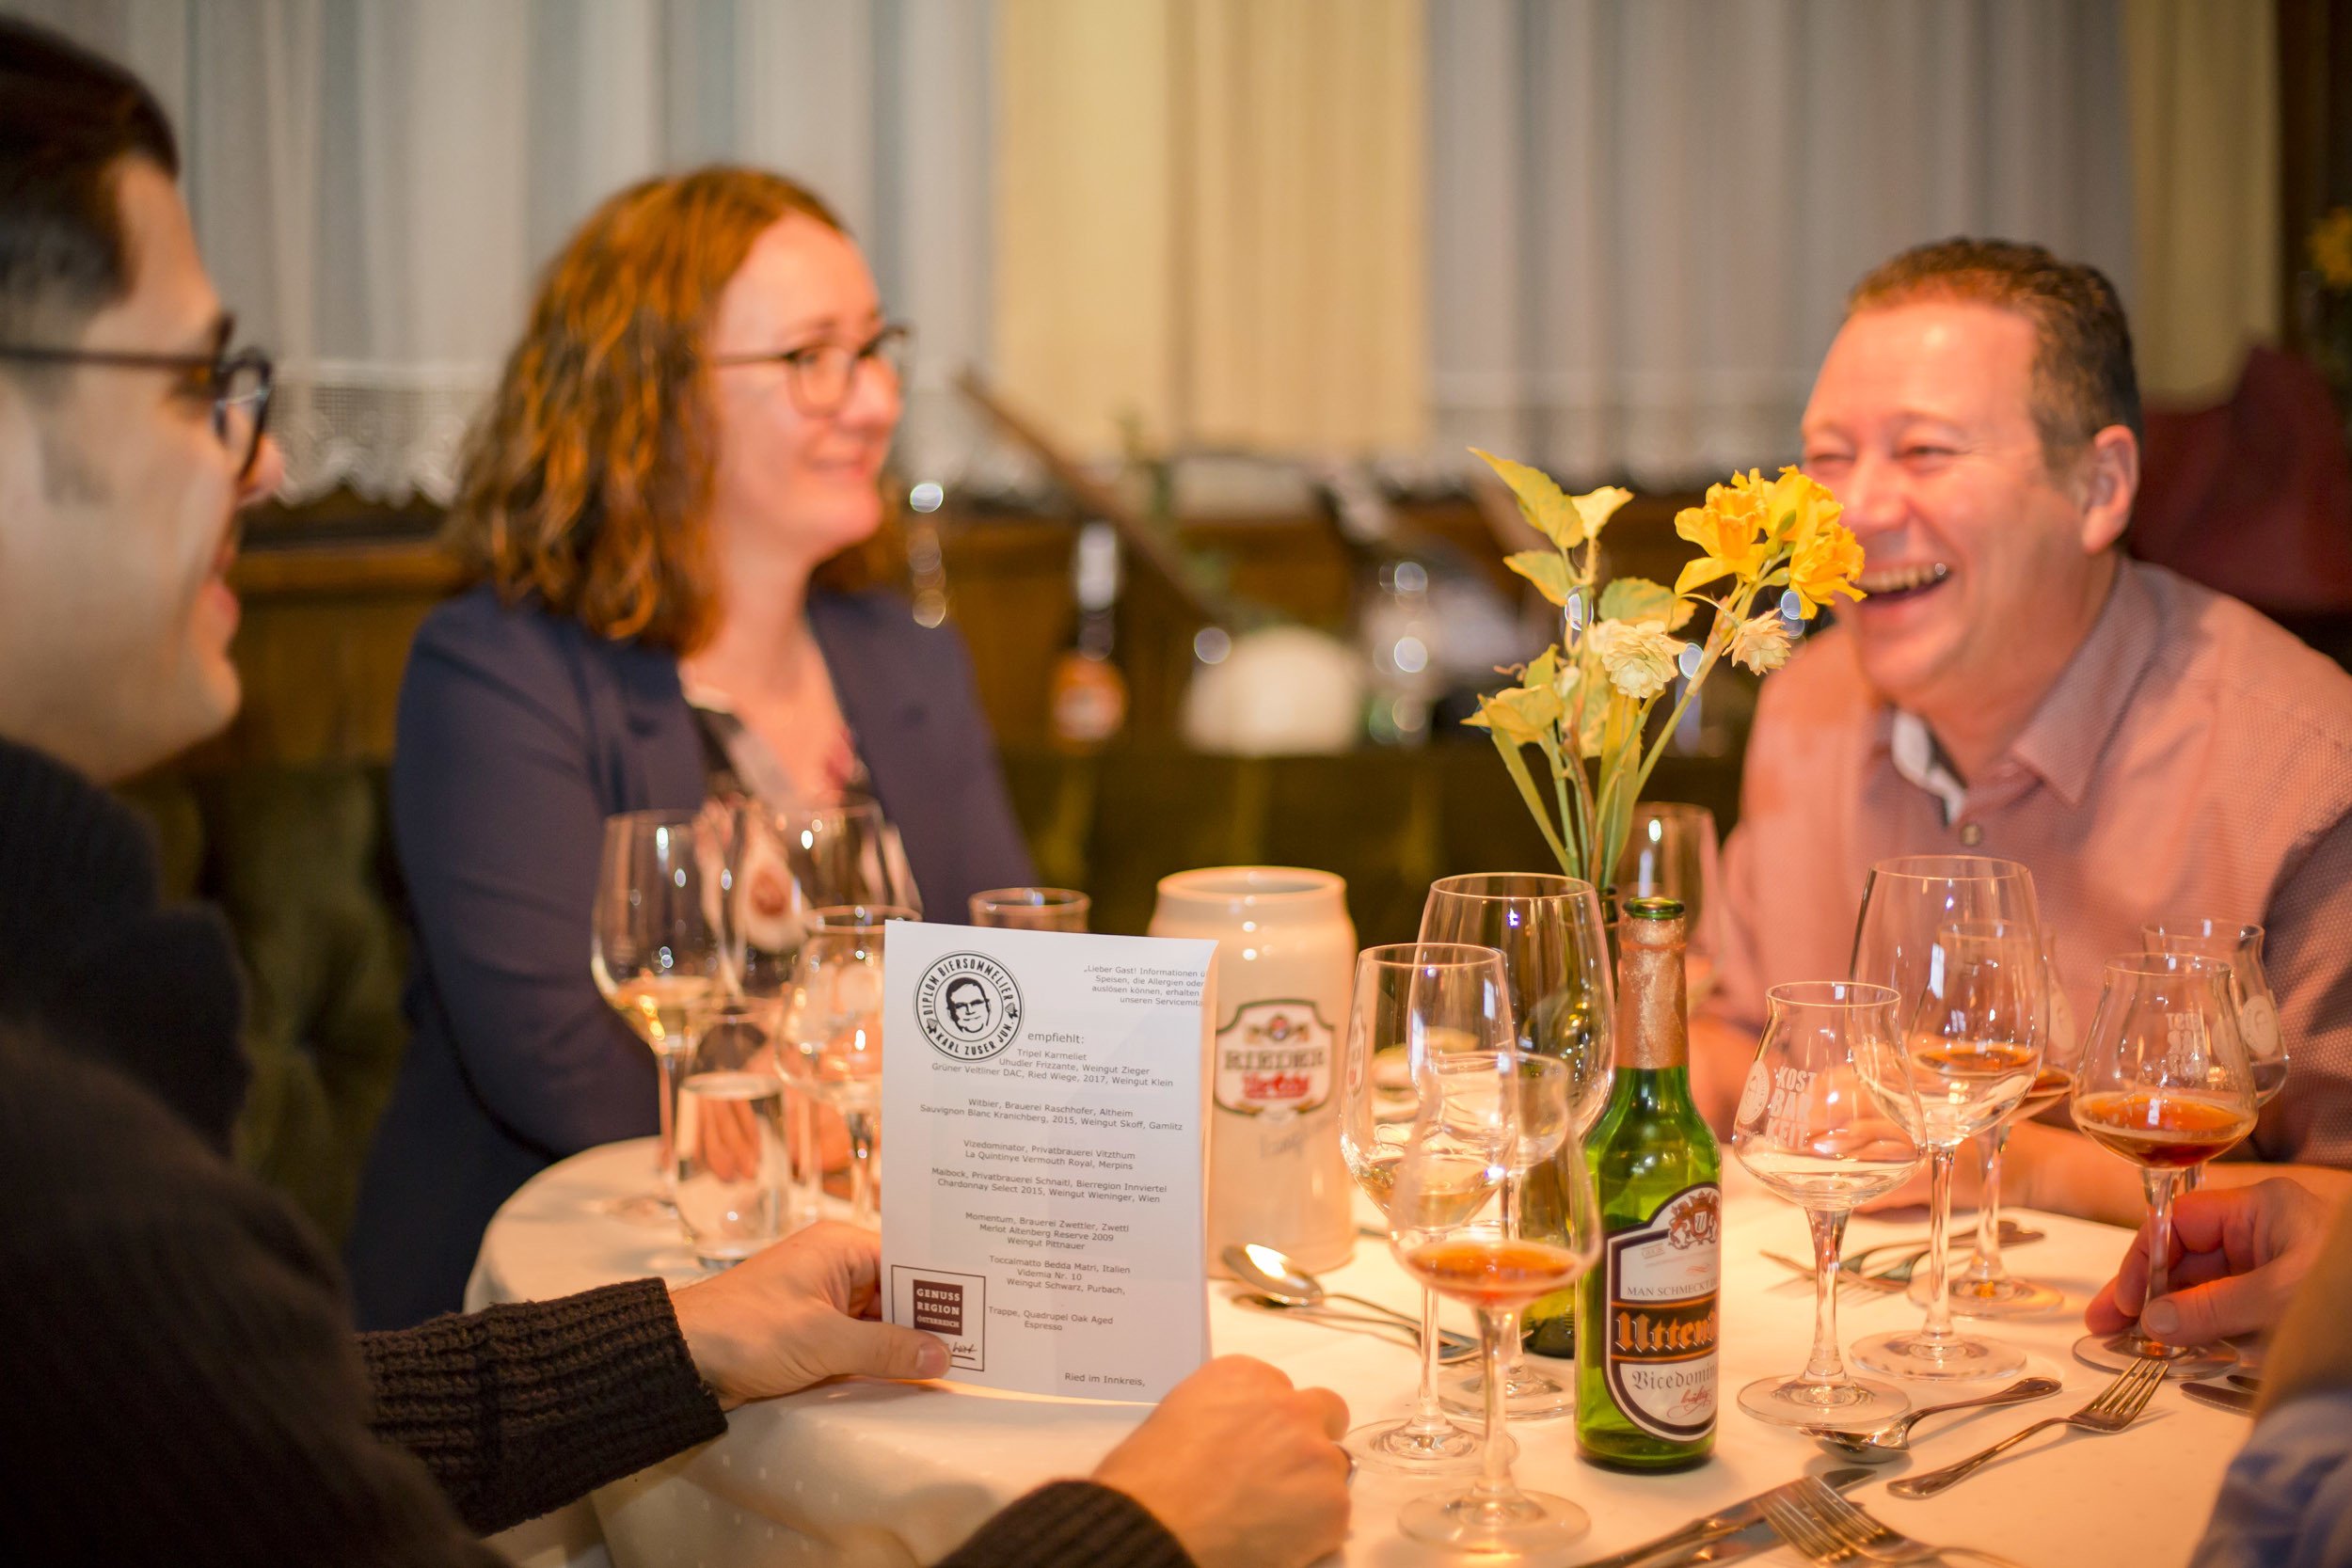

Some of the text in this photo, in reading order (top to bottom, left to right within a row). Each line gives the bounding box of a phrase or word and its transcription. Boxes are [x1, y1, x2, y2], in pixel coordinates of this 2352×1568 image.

[1140, 967, 1198, 977] Informationen
[922, 958, 1014, 1015] DIPLOM BIERSOMMELIER
[1091, 985, 1127, 993] auslösen
[1166, 989, 1200, 997] erhalten
[1148, 978, 1184, 988] Allergien
[935, 1032, 959, 1053] KARL
[964, 1040, 996, 1055] ZUSER
[1027, 1032, 1084, 1044] empfiehlt:
[1017, 1048, 1087, 1061] Tripel Karmeliet
[931, 1062, 1173, 1087] Grüner Veltliner DAC, Ried Wiege, 2017, Weingut Klein
[999, 1057, 1151, 1076] Uhudler Frizzante, Weingut Zieger
[1776, 1066, 1817, 1093] KOST
[968, 1098, 1133, 1117] Witbier, Brauerei Raschhofer, Altheim
[1770, 1087, 1813, 1123] BAR
[920, 1104, 1183, 1131] Sauvignon Blanc Kranichberg, 2015, Weingut Skoff, Gamlitz
[963, 1139, 1136, 1159] Vizedominator, Privatbrauerei Vitzthum
[978, 1150, 1020, 1163] Quintinye
[1023, 1155, 1065, 1165] Vermouth
[1068, 1158, 1095, 1169] Royal,
[1098, 1161, 1133, 1171] Merpins
[931, 1167, 969, 1179] Maibock,
[972, 1171, 1033, 1184] Privatbrauerei
[1076, 1180, 1121, 1191] Bierregion
[1124, 1182, 1168, 1193] Innviertel
[937, 1178, 1160, 1203] Chardonnay Select 2015, Weingut Wieninger, Wien
[965, 1212, 1129, 1232] Momentum, Brauerei Zwettler, Zwettl
[979, 1224, 1114, 1242] Merlot Altenberg Reserve 2009
[1007, 1236, 1085, 1250] Weingut Pittnauer
[989, 1255, 1131, 1274] Toccalmatto Bedda Matri, Italien
[1055, 1270, 1068, 1279] Nr.
[1072, 1273, 1082, 1281] 10
[916, 1288, 961, 1302] GENUSS
[1007, 1277, 1126, 1295] Weingut Schwarz, Purbach,
[1627, 1286, 1654, 1296] MAN
[1658, 1280, 1709, 1295] SCHMECKT
[916, 1302, 961, 1316] REGION
[988, 1306, 1114, 1325] Trappe, Quadrupel Oak Aged
[916, 1315, 960, 1328] ÖSTERREICH
[1025, 1320, 1063, 1331] Espresso
[1064, 1372, 1145, 1387] Ried im Innkreis,
